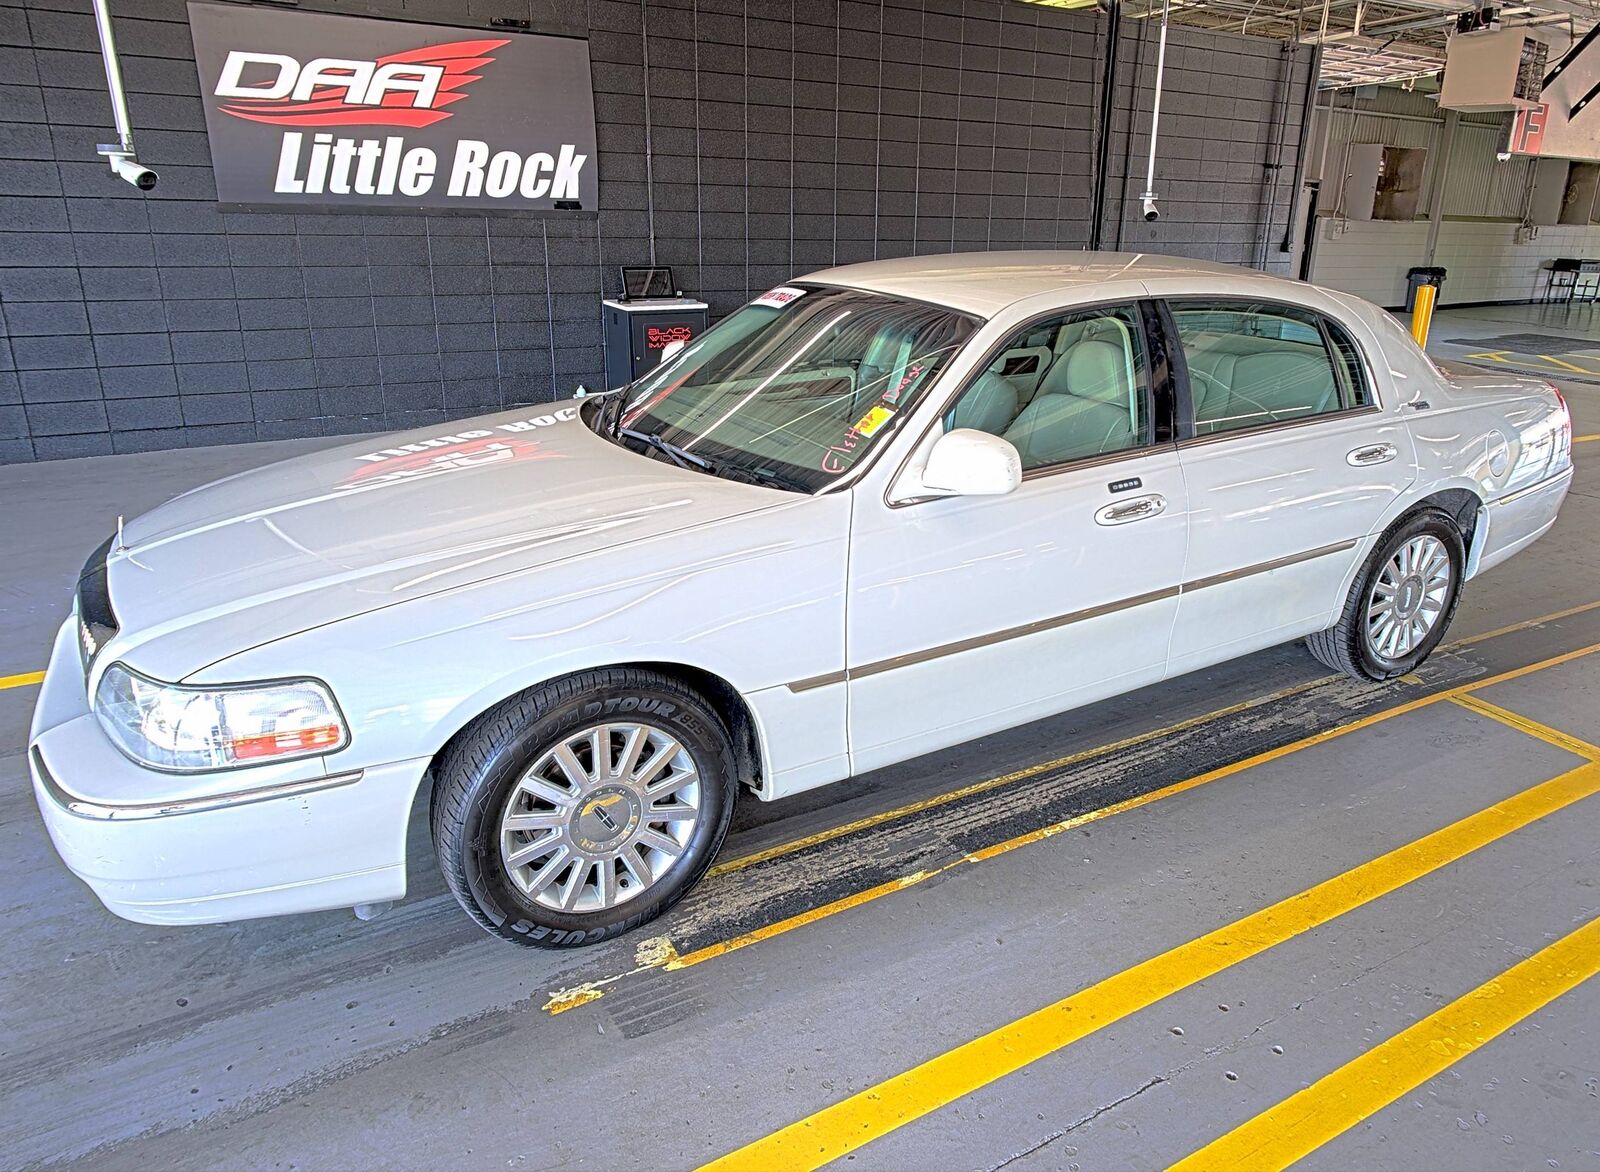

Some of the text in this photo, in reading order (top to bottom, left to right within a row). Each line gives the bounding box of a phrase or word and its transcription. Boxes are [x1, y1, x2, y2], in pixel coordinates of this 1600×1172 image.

[214, 50, 446, 109] DAA
[1518, 104, 1545, 153] F
[274, 131, 588, 200] Little Rock
[648, 327, 692, 335] BLACK
[648, 334, 691, 342] WIDOW
